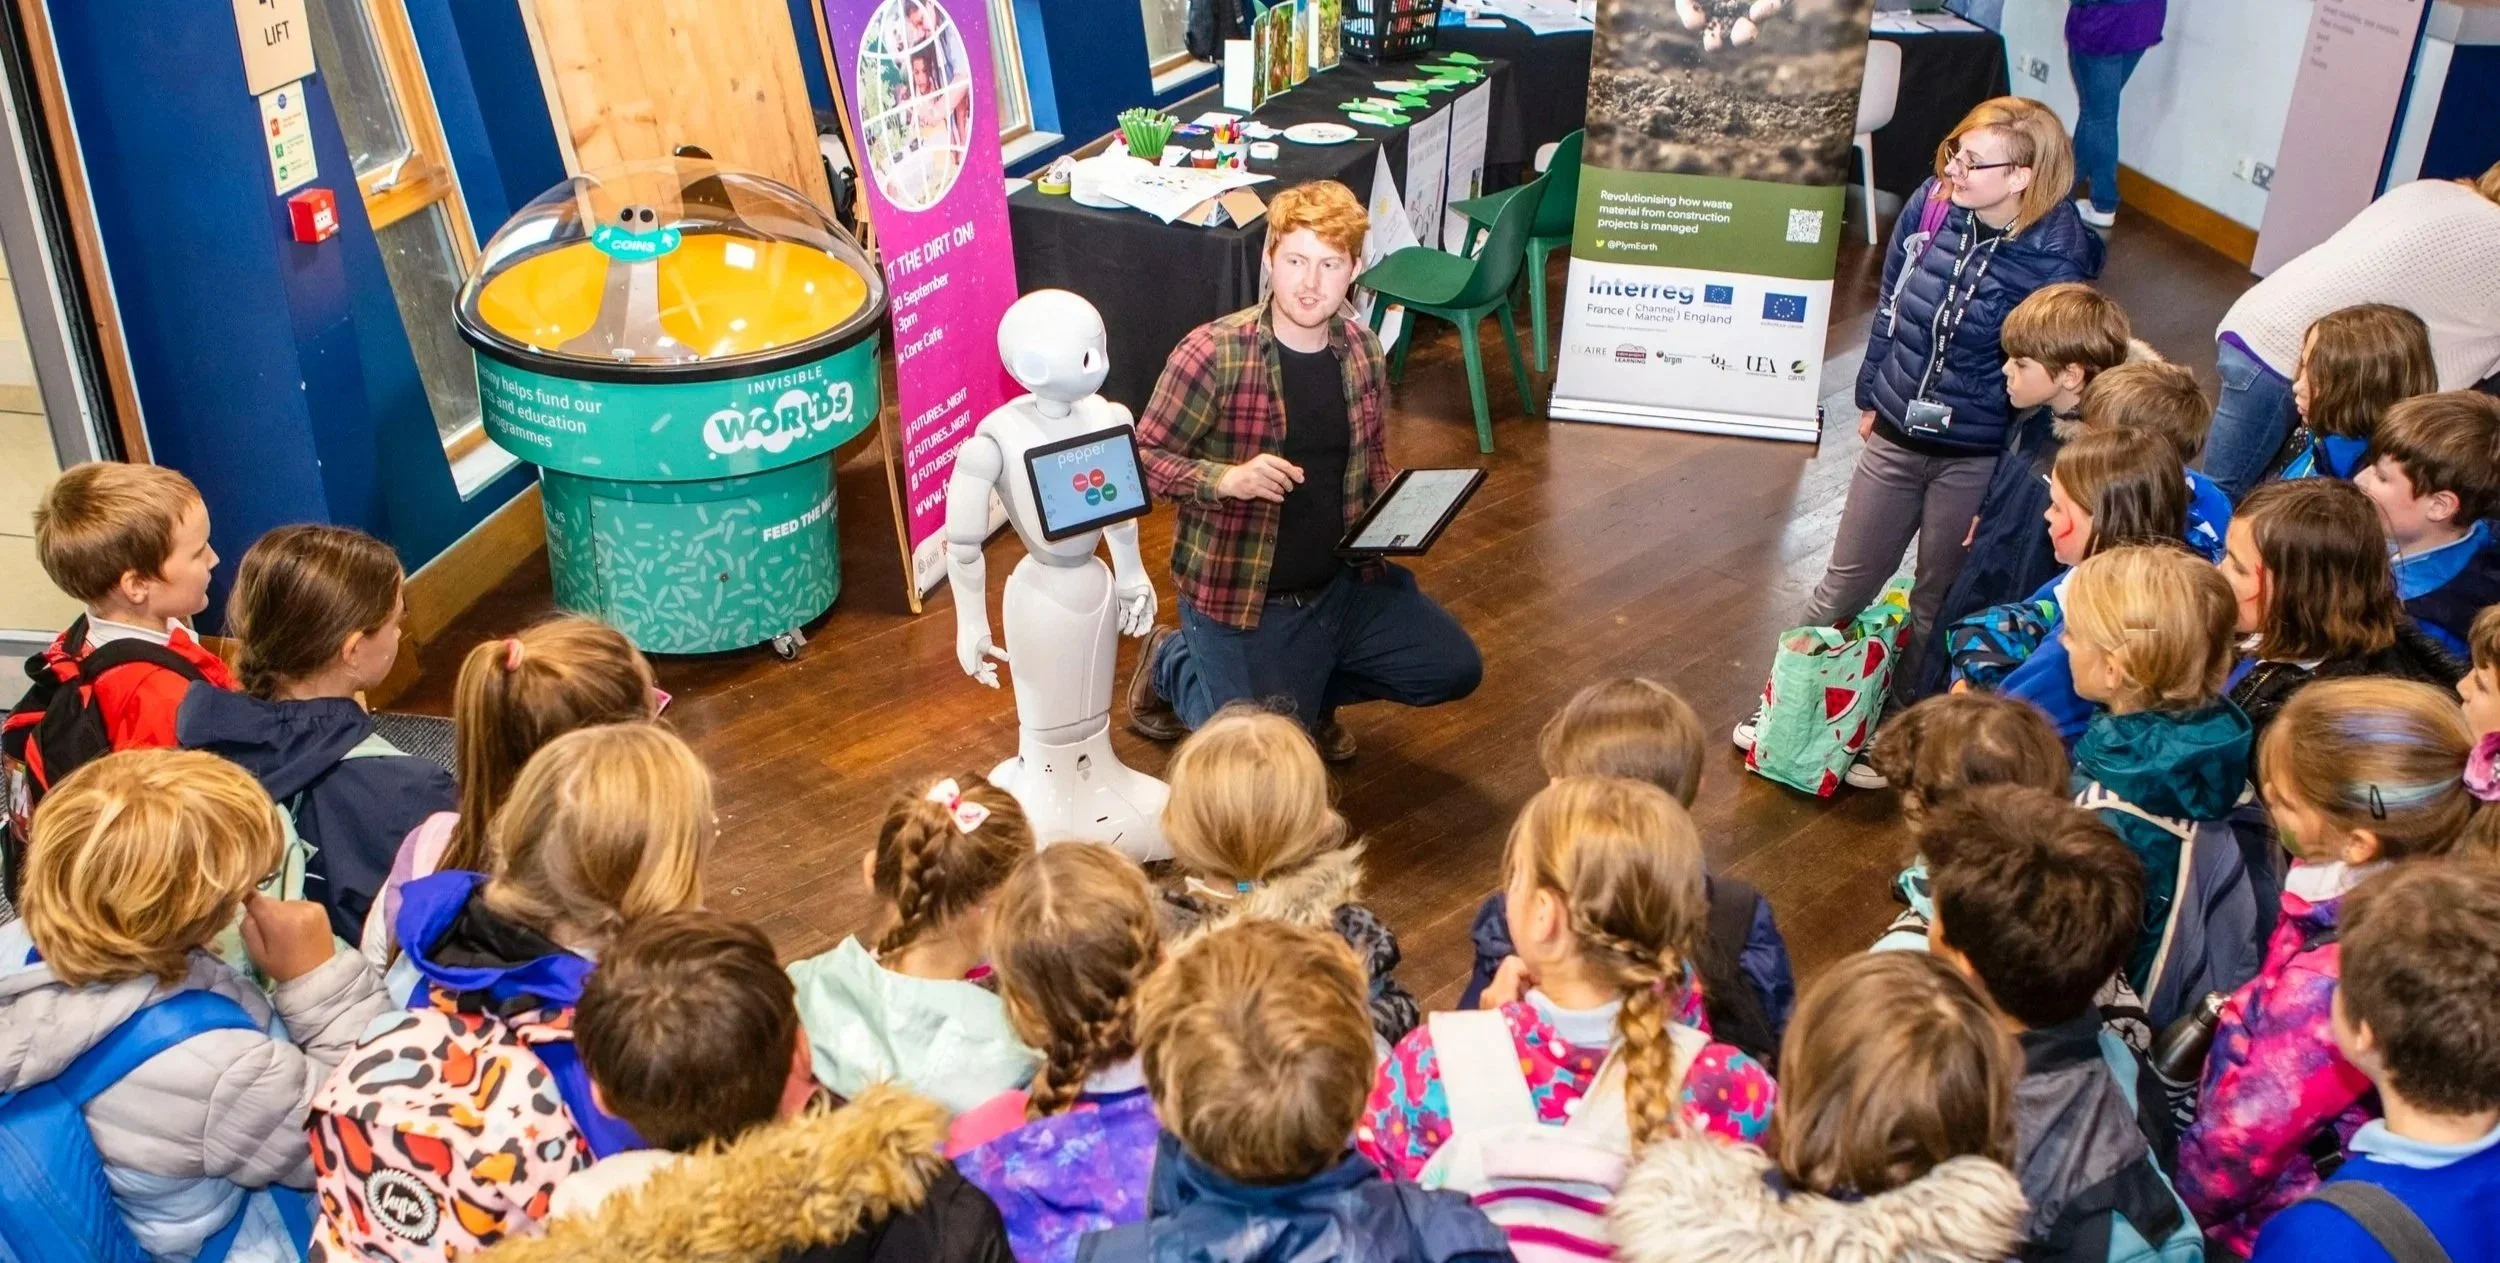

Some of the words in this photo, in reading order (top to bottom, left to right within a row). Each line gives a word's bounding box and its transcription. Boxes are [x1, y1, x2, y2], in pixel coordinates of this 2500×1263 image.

[264, 20, 289, 46] LIFT
[1600, 190, 1677, 208] Revolutionising
[1678, 195, 1700, 207] how
[1702, 200, 1733, 210] waste
[1599, 205, 1640, 217] material
[1641, 206, 1665, 218] from
[1667, 210, 1731, 223] construction
[1598, 218, 1639, 231] projects
[1640, 220, 1650, 231] is
[1651, 222, 1699, 234] managed
[611, 239, 657, 253] COINS
[896, 248, 923, 276] THE
[923, 232, 951, 264] DIRT
[953, 220, 975, 248] ON!
[1607, 239, 1658, 252] @PlymEarth
[1960, 233, 1968, 251] STAFF
[1953, 259, 1961, 276] STAFF
[1977, 260, 1988, 277] STAFF
[903, 272, 949, 306] September
[1588, 275, 1695, 304] Interreg
[1948, 285, 1956, 302] STAFF
[1965, 284, 1976, 301] STAFF
[1586, 303, 1624, 316] France
[1635, 303, 1676, 314] Channel
[1634, 313, 1674, 323] Manche
[1683, 313, 1733, 326] England
[1942, 309, 1950, 327] STAFF
[904, 340, 923, 359] Core
[923, 327, 944, 346] Cafe
[1937, 335, 1946, 353] STAFF
[748, 365, 823, 395] INVISIBLE
[501, 375, 533, 401] helps
[536, 388, 570, 410] fund
[574, 399, 602, 414] our
[496, 395, 515, 415] and
[517, 405, 587, 434] education
[714, 387, 848, 443] WORLDS
[488, 409, 553, 448] programmes
[1057, 443, 1105, 469] pepper
[763, 519, 799, 542] FEED
[800, 505, 821, 528] THE
[381, 1183, 423, 1223] hype
